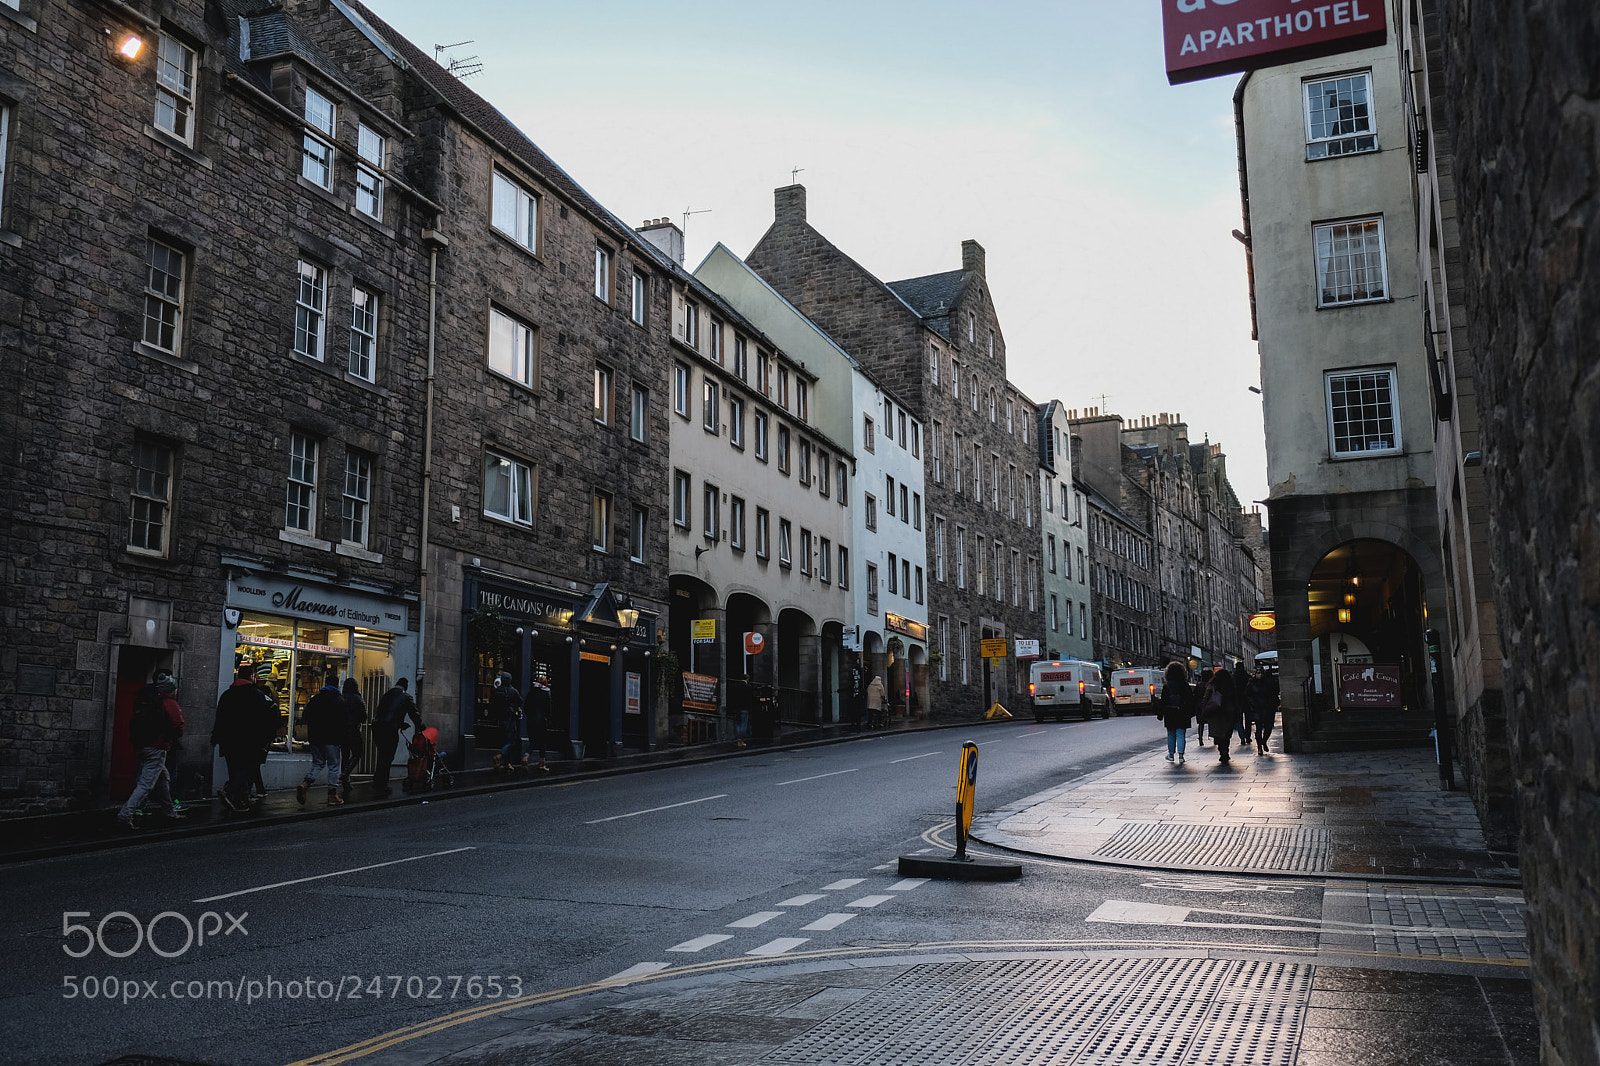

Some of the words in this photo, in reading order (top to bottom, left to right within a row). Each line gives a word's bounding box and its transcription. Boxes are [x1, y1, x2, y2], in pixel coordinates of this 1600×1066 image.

[1179, 0, 1370, 56] APARTHOTEL
[237, 586, 266, 596] WOOLLENS
[480, 590, 502, 608] THE
[272, 586, 338, 616] Macraes
[338, 609, 346, 618] of
[347, 609, 380, 625] Edinburgh
[636, 625, 647, 637] 232
